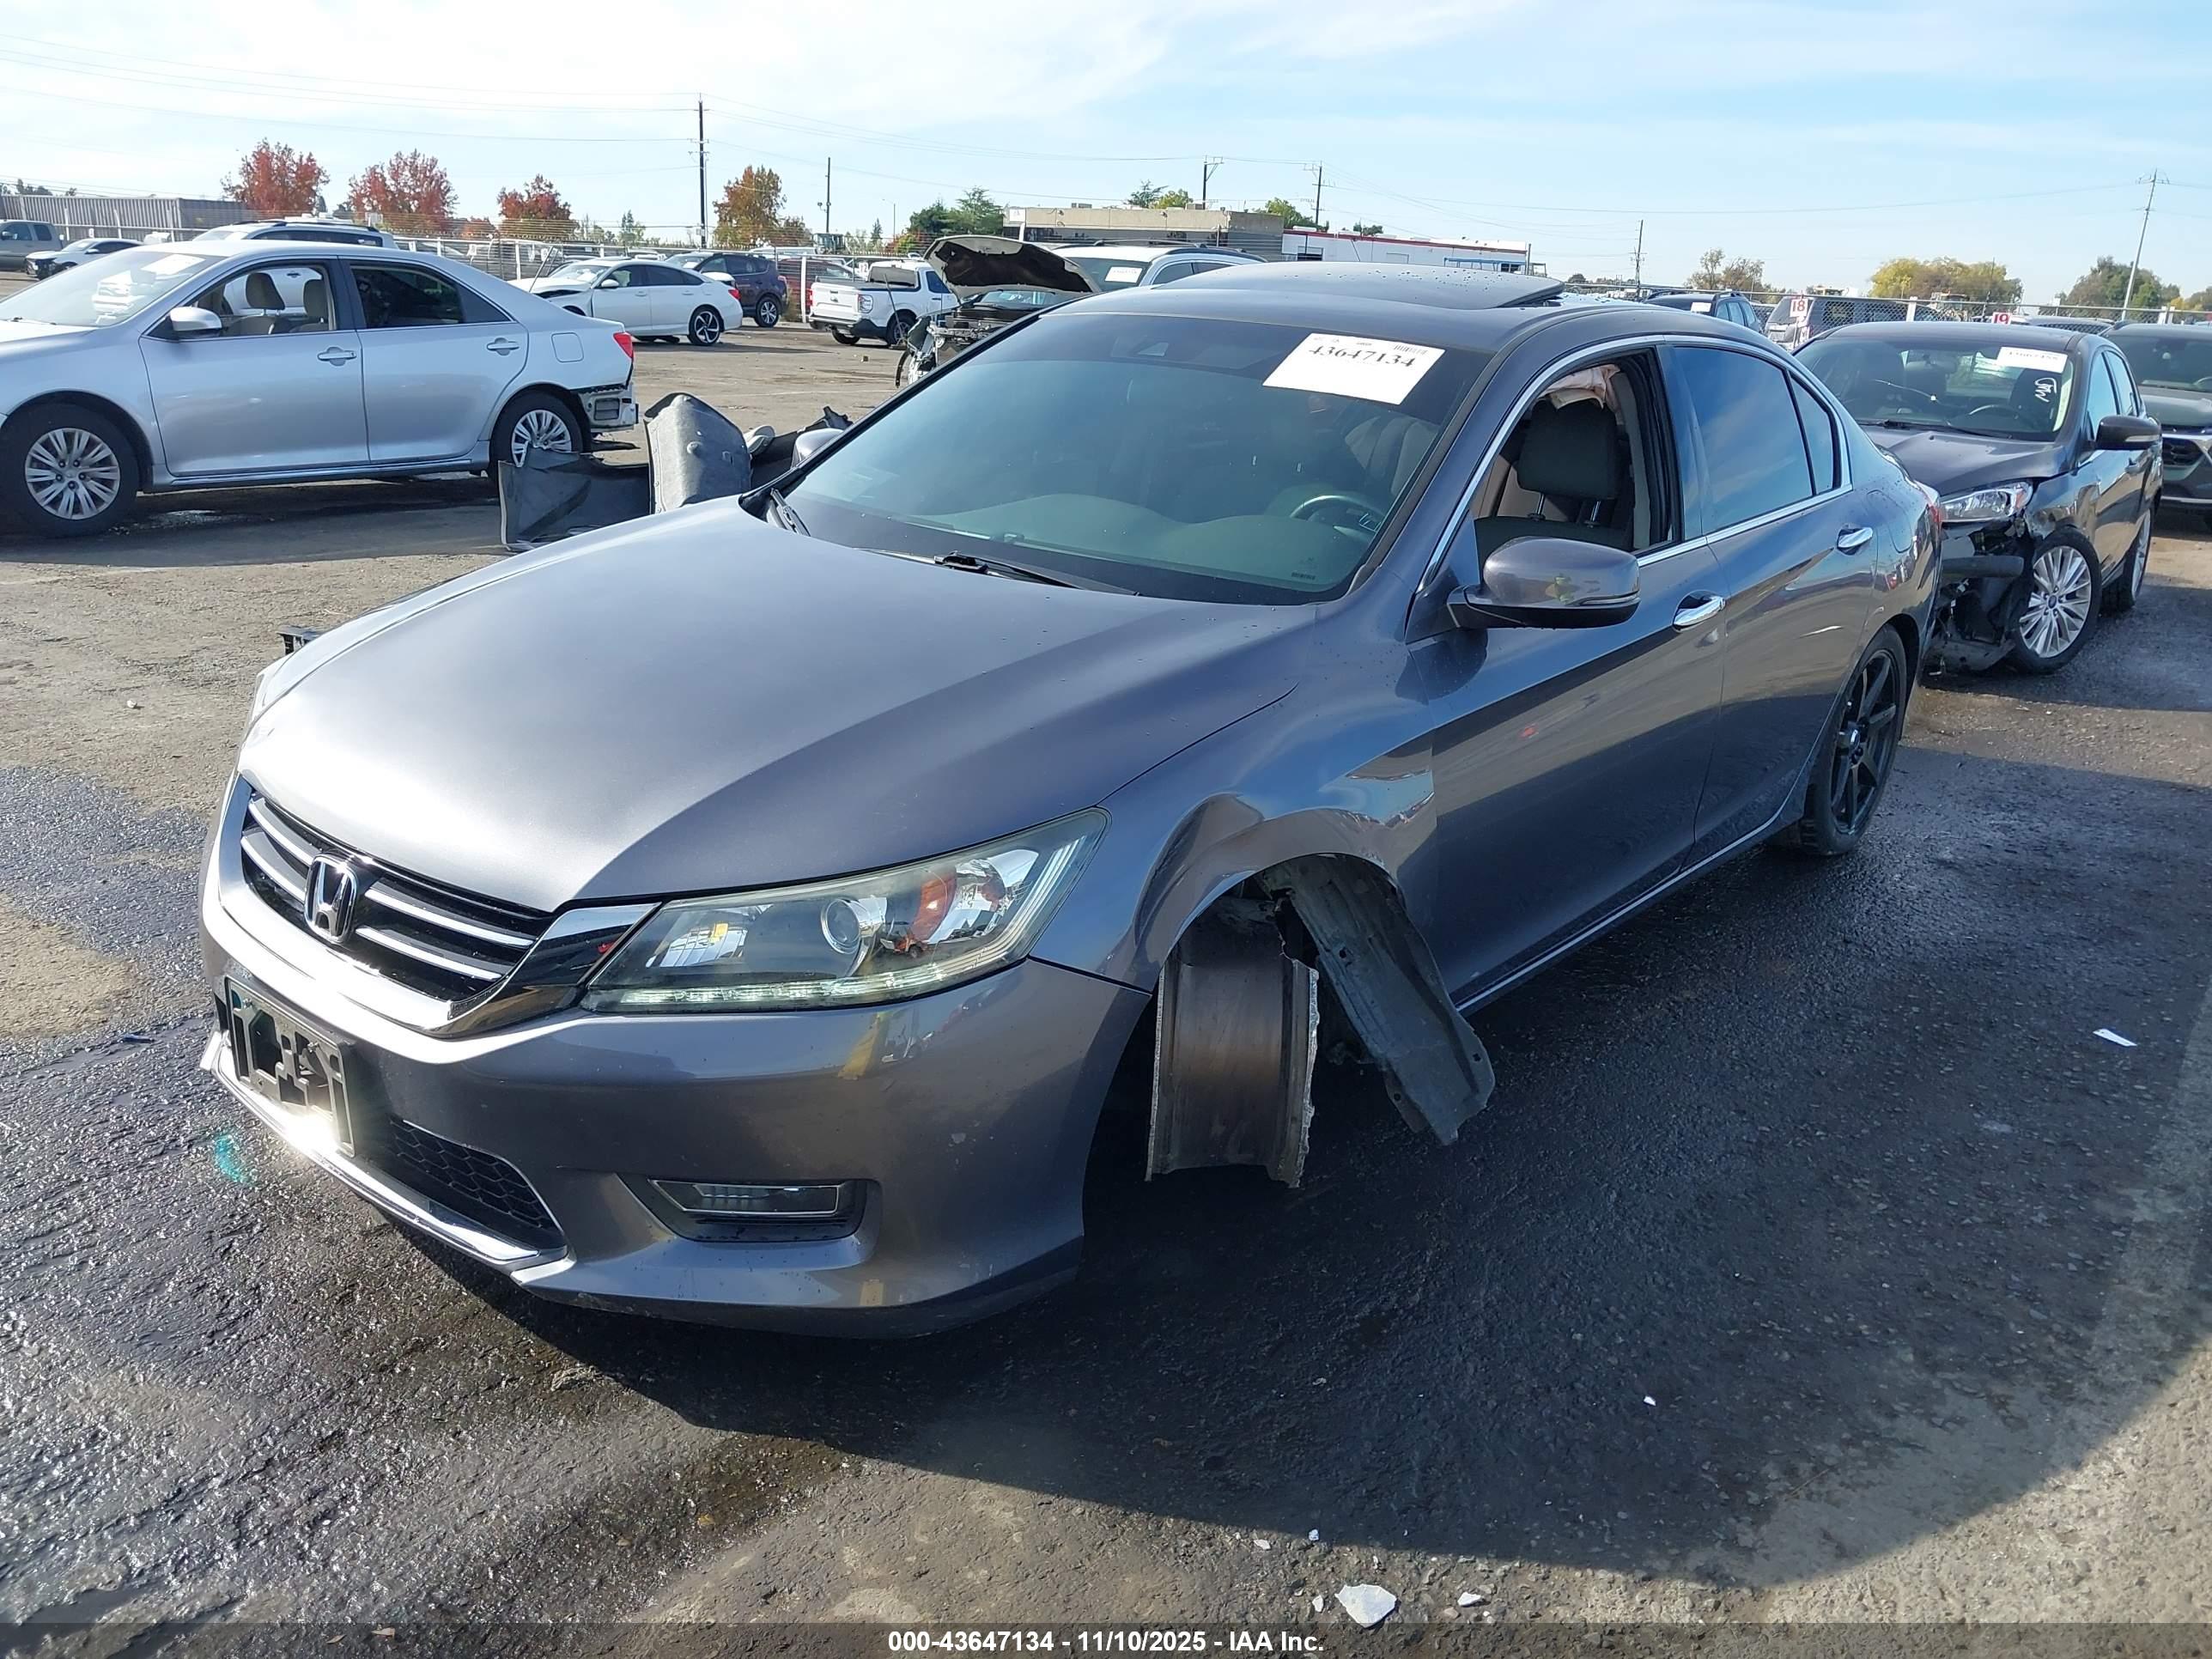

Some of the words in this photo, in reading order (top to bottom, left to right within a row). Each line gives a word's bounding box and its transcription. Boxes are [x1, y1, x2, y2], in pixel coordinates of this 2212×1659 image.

[1793, 301, 1805, 312] 18
[1994, 313, 2009, 325] 19
[1310, 345, 1415, 367] 43647134
